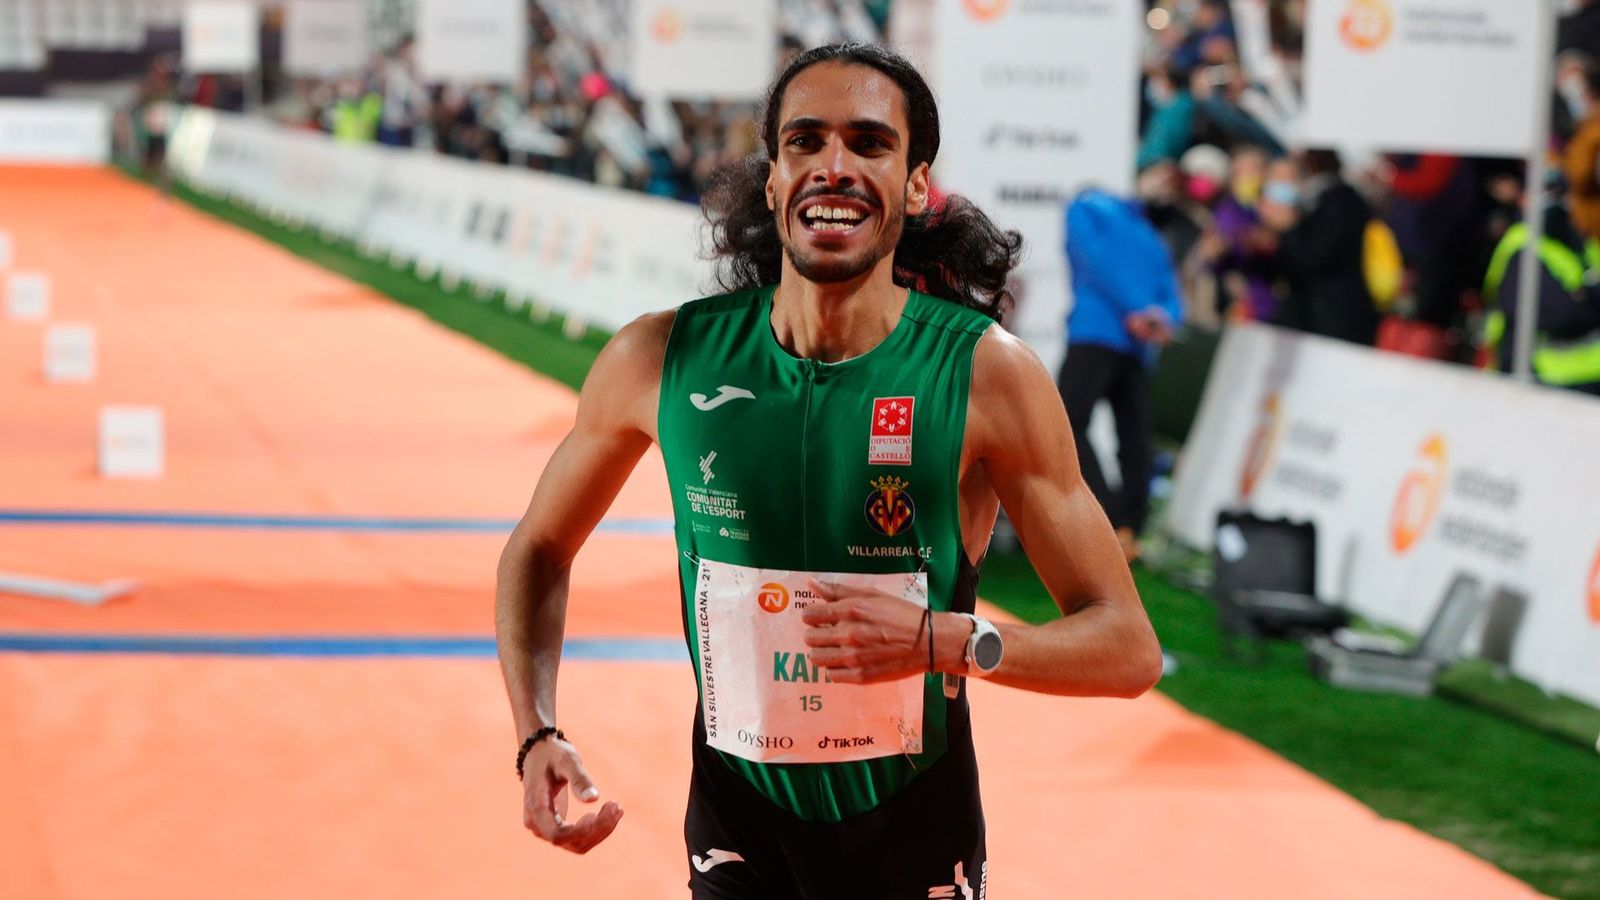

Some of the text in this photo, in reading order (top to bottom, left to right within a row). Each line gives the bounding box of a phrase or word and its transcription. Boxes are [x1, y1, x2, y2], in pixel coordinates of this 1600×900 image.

[687, 491, 738, 509] COMUNITAT
[691, 502, 746, 520] DE L'ESPORT
[847, 544, 914, 557] VILLARREAL
[699, 590, 710, 652] VALLECANA
[704, 654, 716, 712] SILVESTRE
[799, 694, 823, 712] 15
[709, 716, 717, 738] SAN
[737, 728, 794, 749] OYSHO
[831, 735, 874, 749] TikTok
